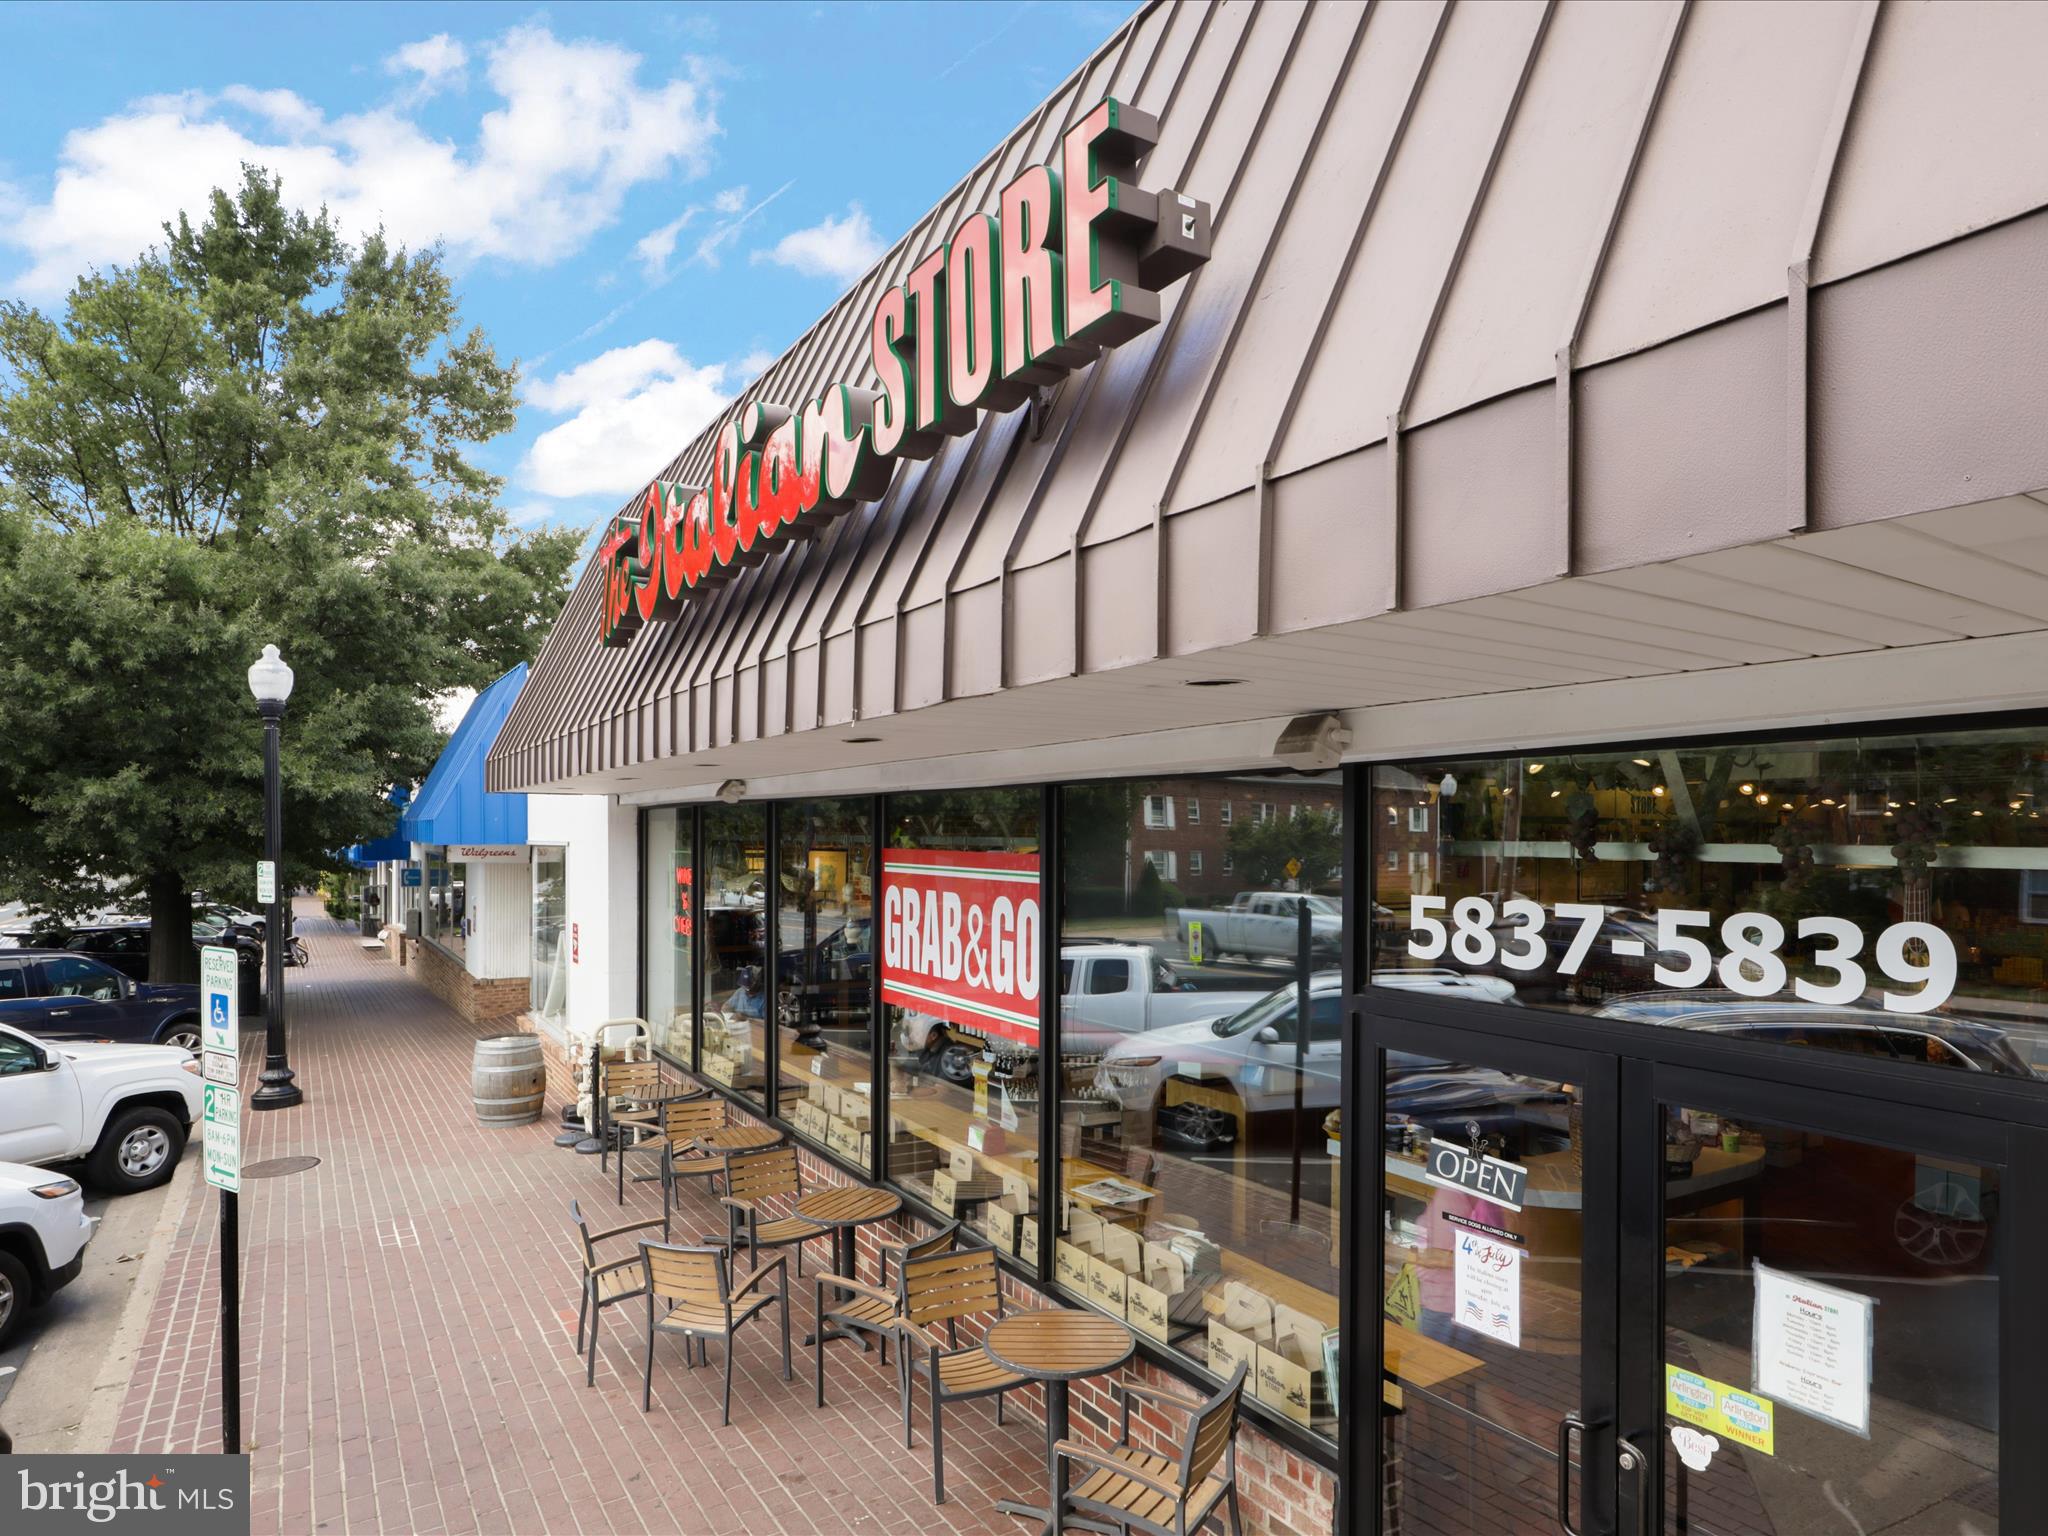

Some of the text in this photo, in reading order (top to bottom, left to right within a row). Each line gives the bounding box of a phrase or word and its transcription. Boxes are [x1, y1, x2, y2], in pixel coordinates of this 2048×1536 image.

[599, 96, 1120, 647] The Italian STORE
[461, 847, 517, 859] Walgreens
[884, 885, 1040, 1001] GRAB&GO
[204, 956, 234, 974] RESERVED
[1407, 895, 1959, 1014] 5837-5839
[206, 974, 233, 991] PARKING
[205, 1089, 231, 1117] 2 HR
[216, 1107, 237, 1123] PARKING
[207, 1129, 236, 1146] 8AM-6PM
[207, 1147, 237, 1168] MON-SUN
[1435, 1150, 1517, 1201] OPEN
[1448, 1215, 1518, 1240] SERVICE DOGS ALLOWED ONLY
[1481, 1245, 1513, 1272] July
[1792, 1294, 1823, 1311] Italian
[1799, 1306, 1823, 1321] Hours
[1209, 1341, 1234, 1361] Italian
[1260, 1369, 1286, 1390] Italian
[1800, 1375, 1823, 1390] Hours
[1672, 1379, 1711, 1402] Arlington
[1723, 1400, 1767, 1426] Arlington
[1725, 1424, 1765, 1447] WINNER
